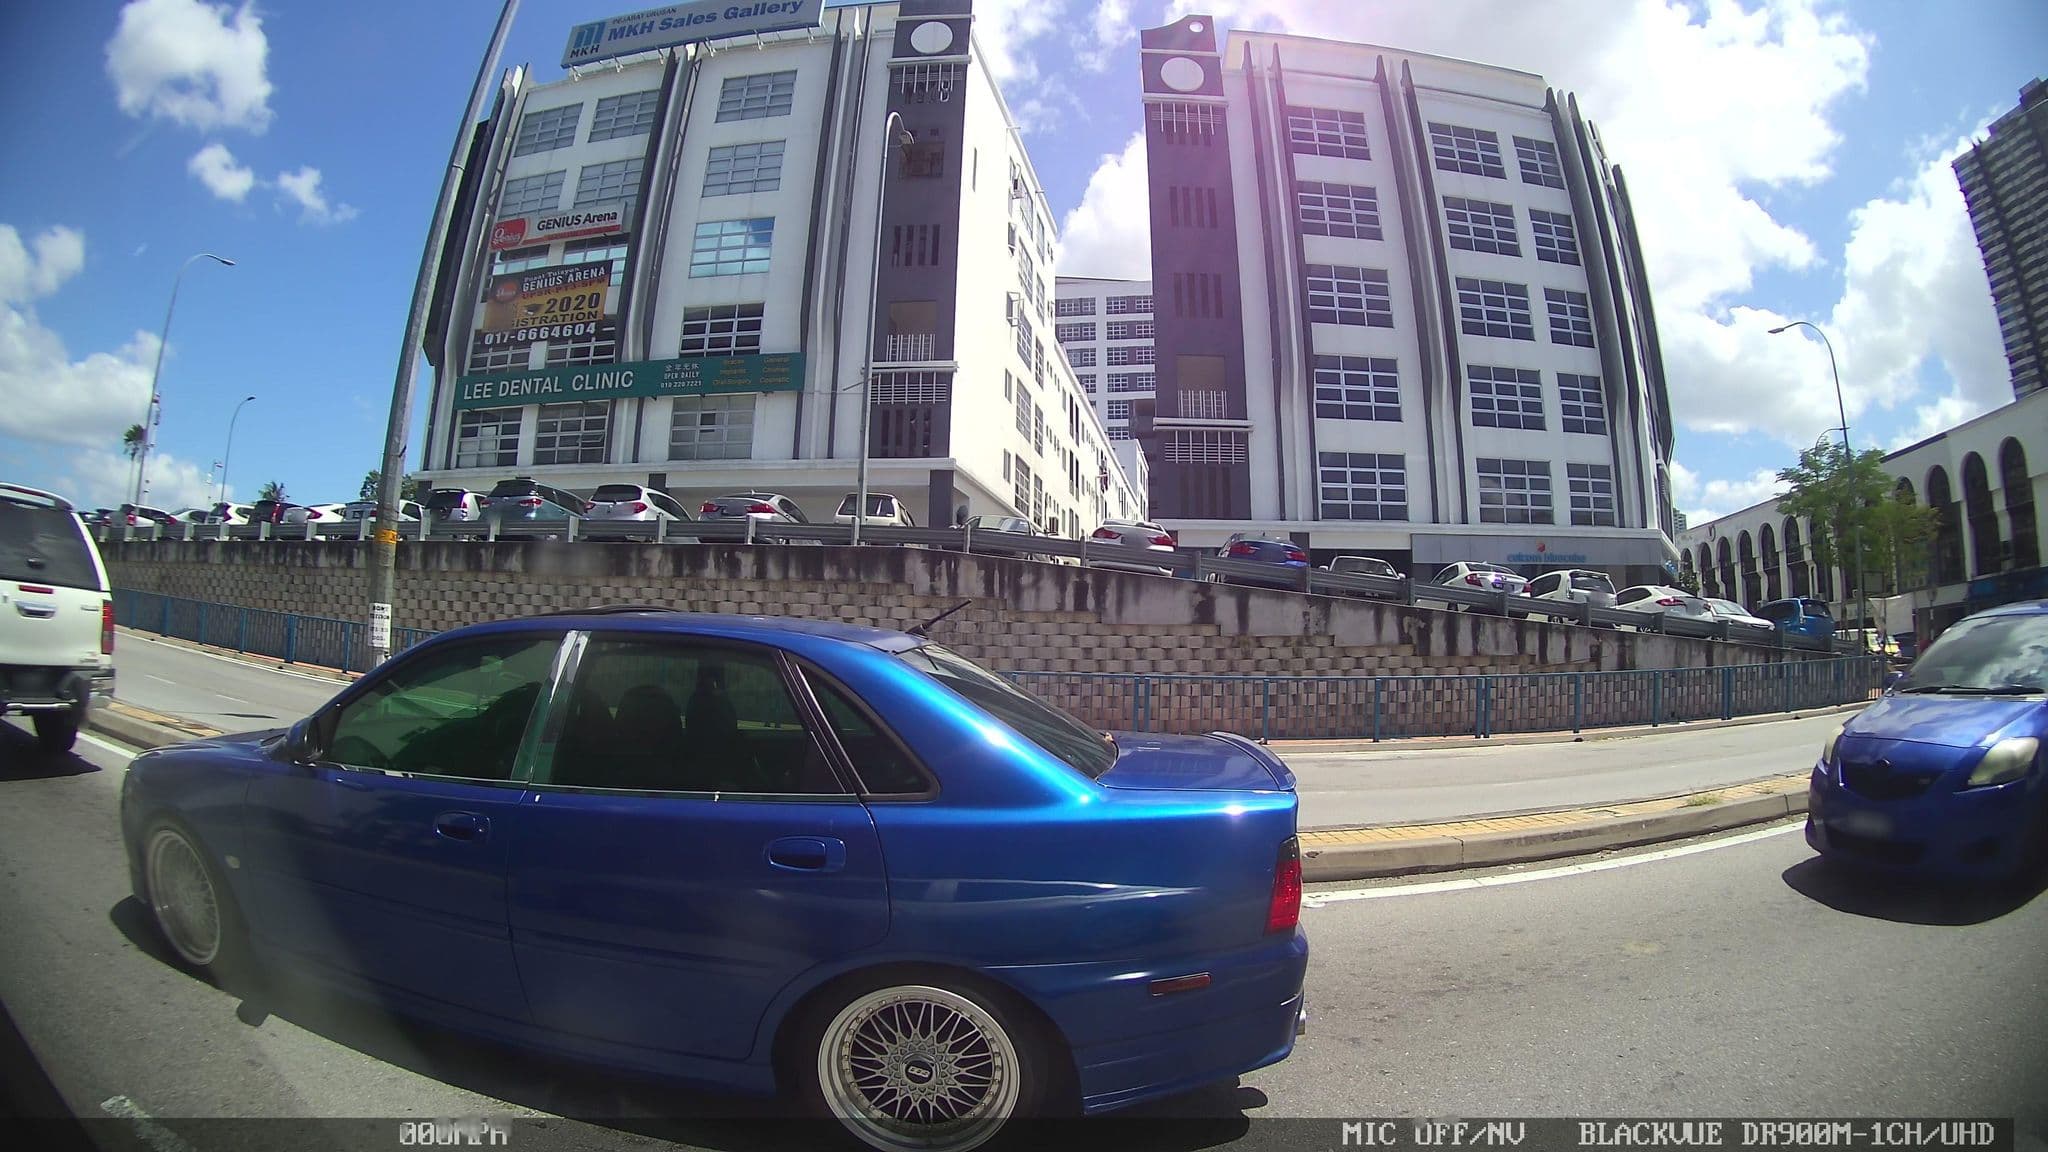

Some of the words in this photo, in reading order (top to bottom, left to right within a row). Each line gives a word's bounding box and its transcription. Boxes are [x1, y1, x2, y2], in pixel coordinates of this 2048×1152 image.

[607, 20, 655, 41] MKH
[658, 12, 717, 31] Sales
[723, 0, 803, 20] Gallery
[569, 44, 600, 58] MKH
[537, 214, 582, 231] GENIUS
[582, 211, 618, 225] Arena
[522, 275, 564, 292] GENIUS
[567, 266, 606, 284] ARENA
[544, 292, 601, 315] 2020
[511, 310, 598, 328] ISTRATION
[484, 321, 597, 345] 017-6664604
[463, 382, 494, 401] LEE
[499, 376, 563, 398] DENTAL
[571, 370, 634, 392] CLINIC
